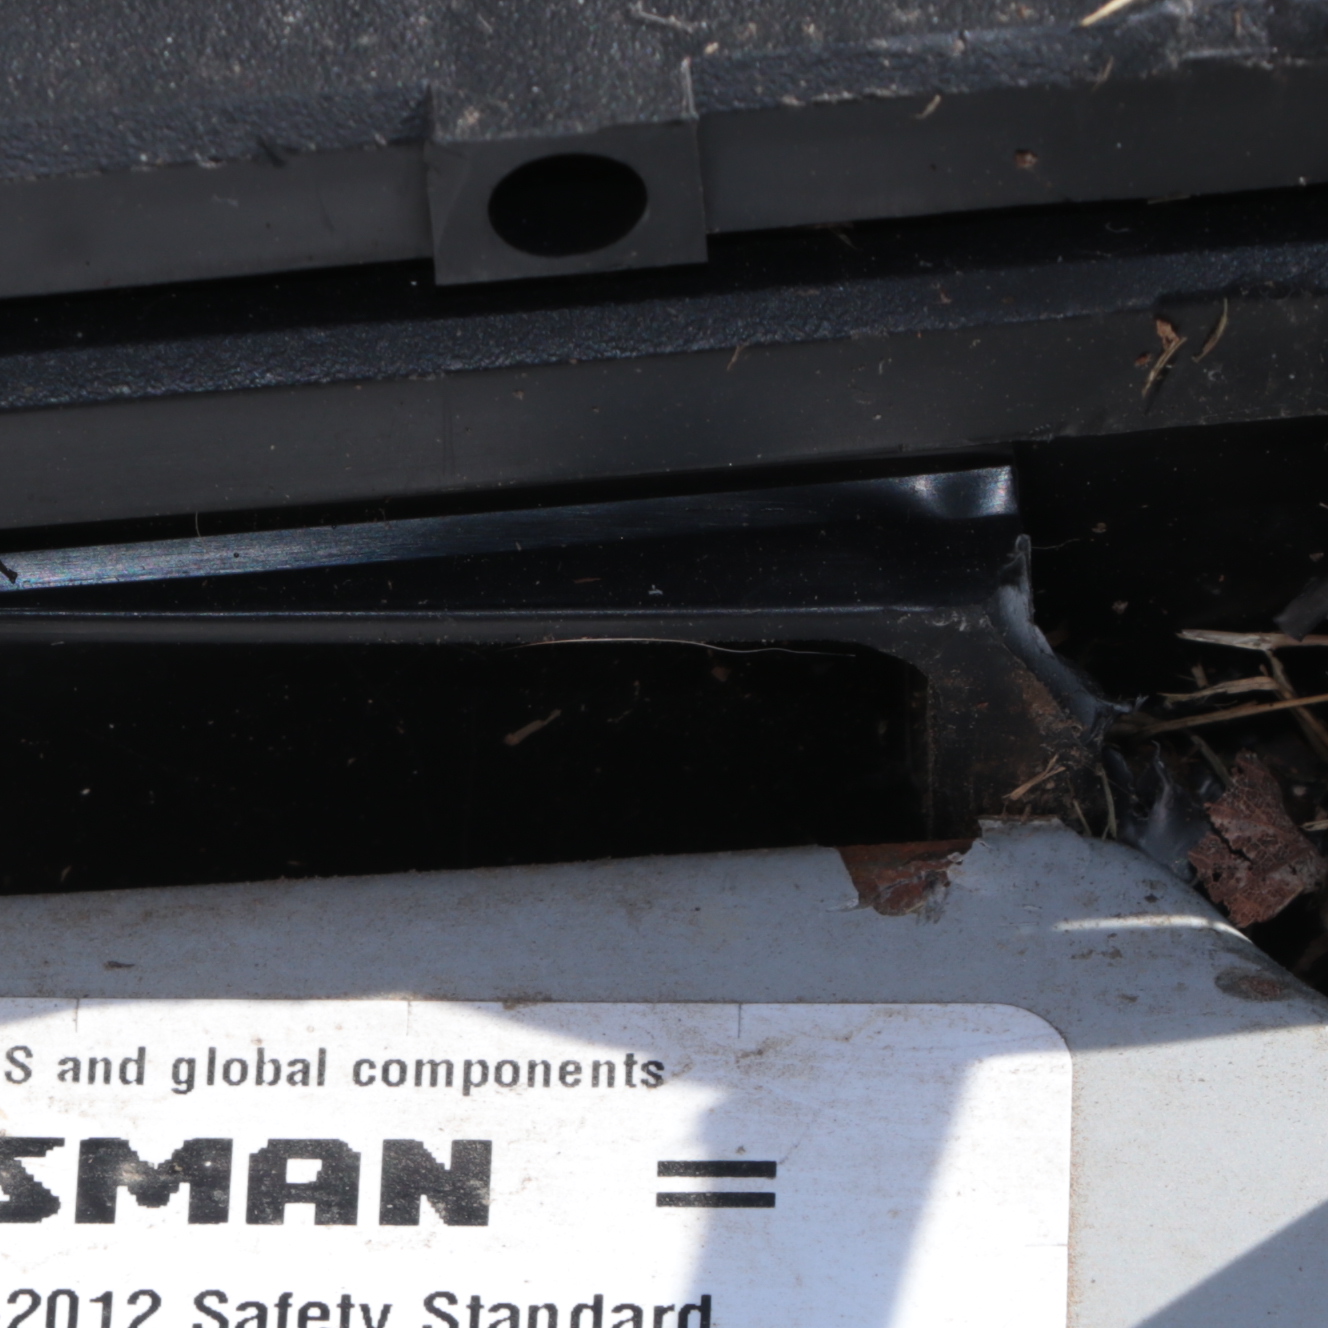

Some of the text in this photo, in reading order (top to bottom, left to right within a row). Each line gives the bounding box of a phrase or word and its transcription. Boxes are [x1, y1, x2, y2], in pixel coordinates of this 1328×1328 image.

[56, 1045, 147, 1086] and
[171, 1046, 327, 1096] global
[352, 1052, 665, 1097] components
